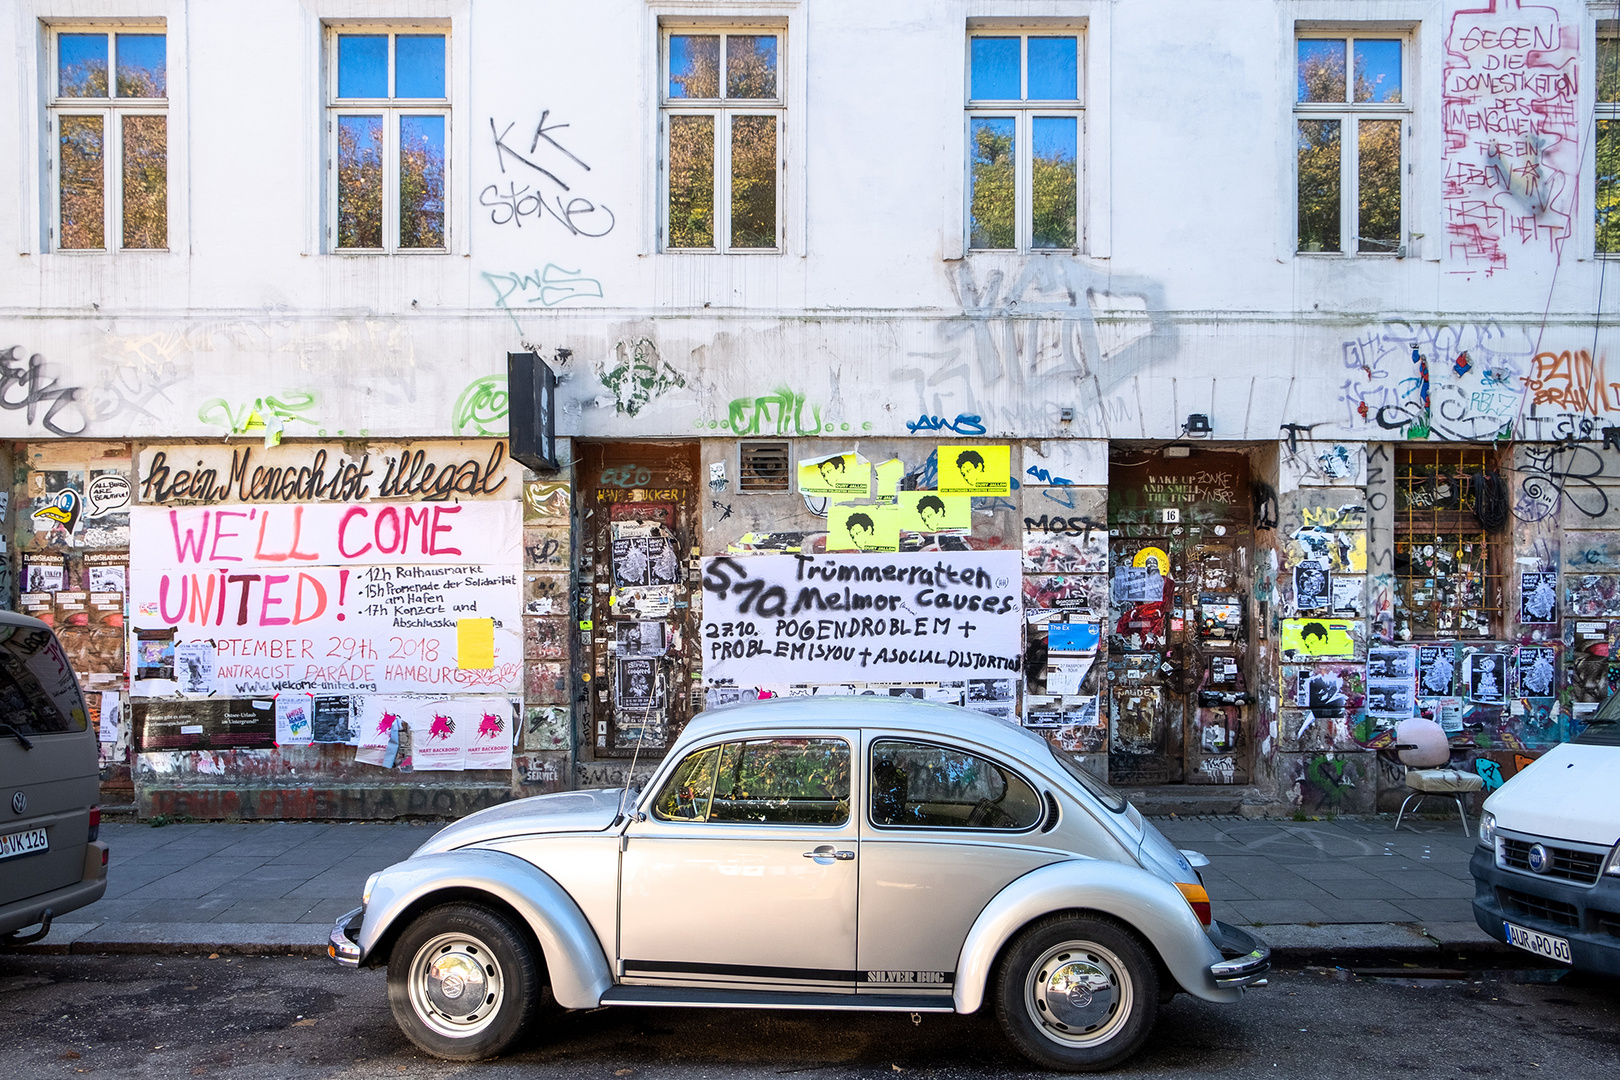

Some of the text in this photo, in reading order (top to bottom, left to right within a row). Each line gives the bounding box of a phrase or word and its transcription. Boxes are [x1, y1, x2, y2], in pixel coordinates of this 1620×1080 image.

[1460, 24, 1553, 50] GEGEN
[1483, 54, 1524, 70] DIE
[1451, 66, 1577, 96] DOMESTIKATION
[1495, 98, 1531, 115] DES
[1453, 107, 1542, 136] MENSCHEN
[218, 447, 329, 501] Mensch
[328, 455, 373, 501] ist
[378, 442, 507, 501] illegal
[1148, 476, 1196, 484] WAKE UP
[1143, 484, 1199, 494] AND SMELL
[1148, 493, 1195, 502] THE FISH
[1166, 510, 1176, 520] 16
[169, 505, 462, 563] WE'LL COME
[396, 565, 484, 579] Rathausmarkt
[794, 554, 992, 589] Trümmerratten
[365, 574, 517, 598] 15h Promenade der Solidarität
[365, 600, 477, 617] 17h Konzert und
[385, 593, 444, 605] am Hafen
[791, 586, 901, 614] Melmor
[915, 588, 1014, 615] Causes
[190, 637, 314, 660] PTEMBER
[326, 637, 378, 661] 29th
[389, 636, 440, 661] 2018
[217, 663, 295, 679] ANTIRACIST
[304, 664, 375, 682] PARADE
[9, 830, 45, 852] VK 126
[1511, 927, 1570, 960] AUR PO 60
[867, 971, 945, 983] SILVER BUG
